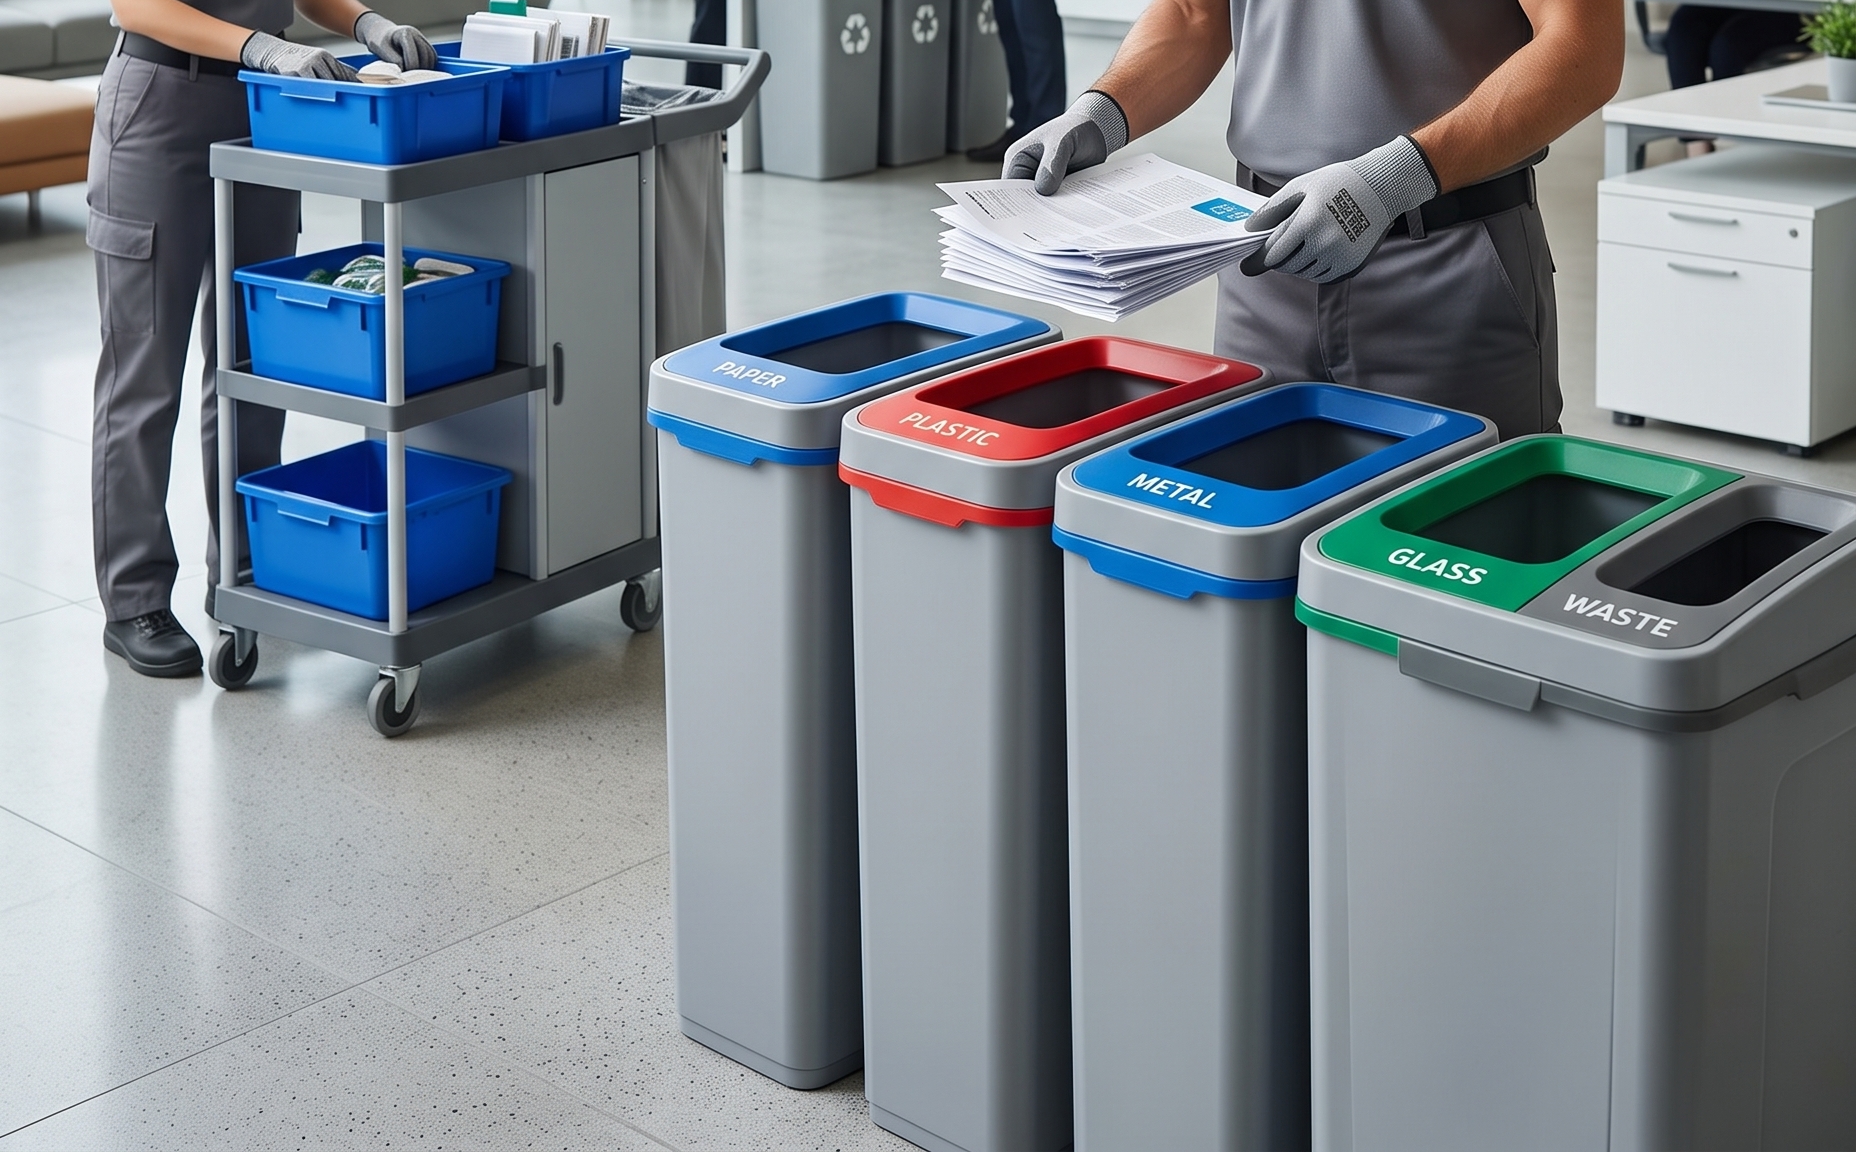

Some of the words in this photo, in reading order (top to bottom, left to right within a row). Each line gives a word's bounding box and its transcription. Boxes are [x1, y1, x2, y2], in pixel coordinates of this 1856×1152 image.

[712, 361, 787, 388] PAPER
[898, 412, 1000, 446] PLASTIC
[1126, 473, 1217, 509] METAL
[1387, 548, 1488, 585] GLASS
[1562, 593, 1679, 638] WASTE
